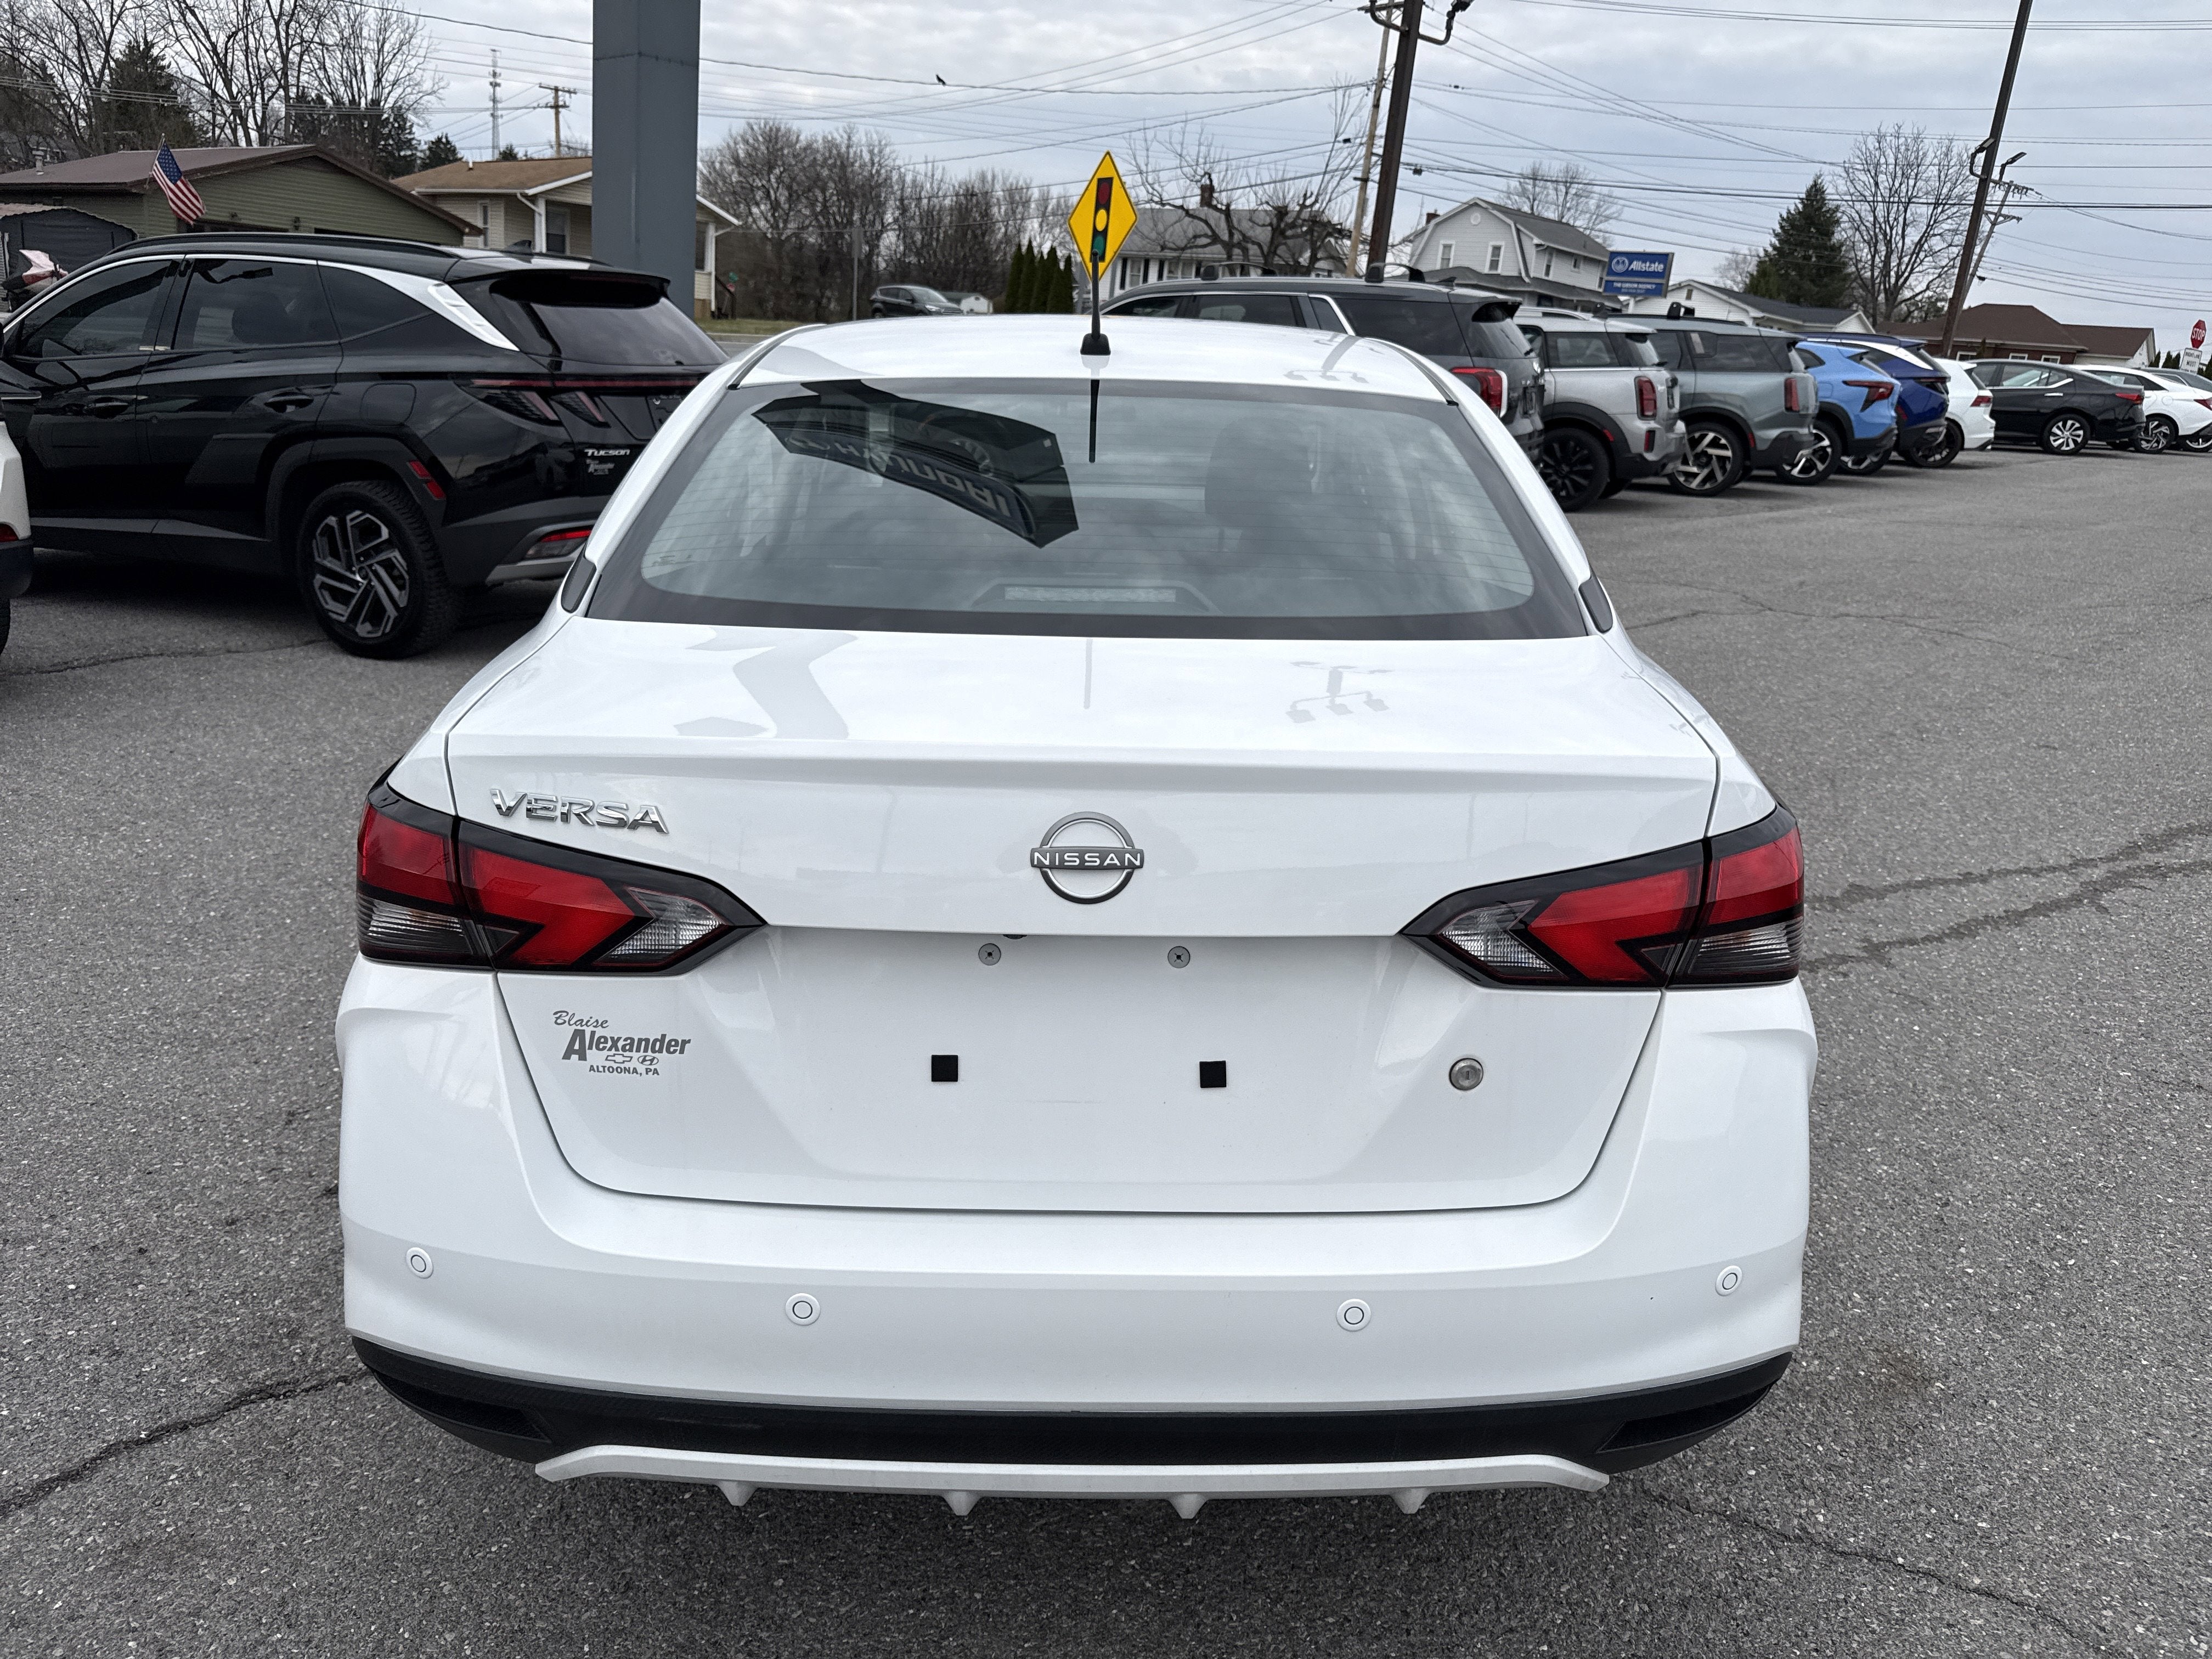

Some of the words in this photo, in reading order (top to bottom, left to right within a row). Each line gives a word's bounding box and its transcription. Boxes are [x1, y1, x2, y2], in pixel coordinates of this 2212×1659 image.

[1628, 259, 1664, 272] Allstate
[2192, 328, 2205, 341] STOP
[489, 788, 670, 834] VERSA
[1034, 851, 1141, 866] NISSAN
[553, 1010, 610, 1029] Blaise
[561, 1029, 691, 1062] Alexander
[589, 1064, 642, 1077] ALTOONA,
[645, 1067, 660, 1076] PA
